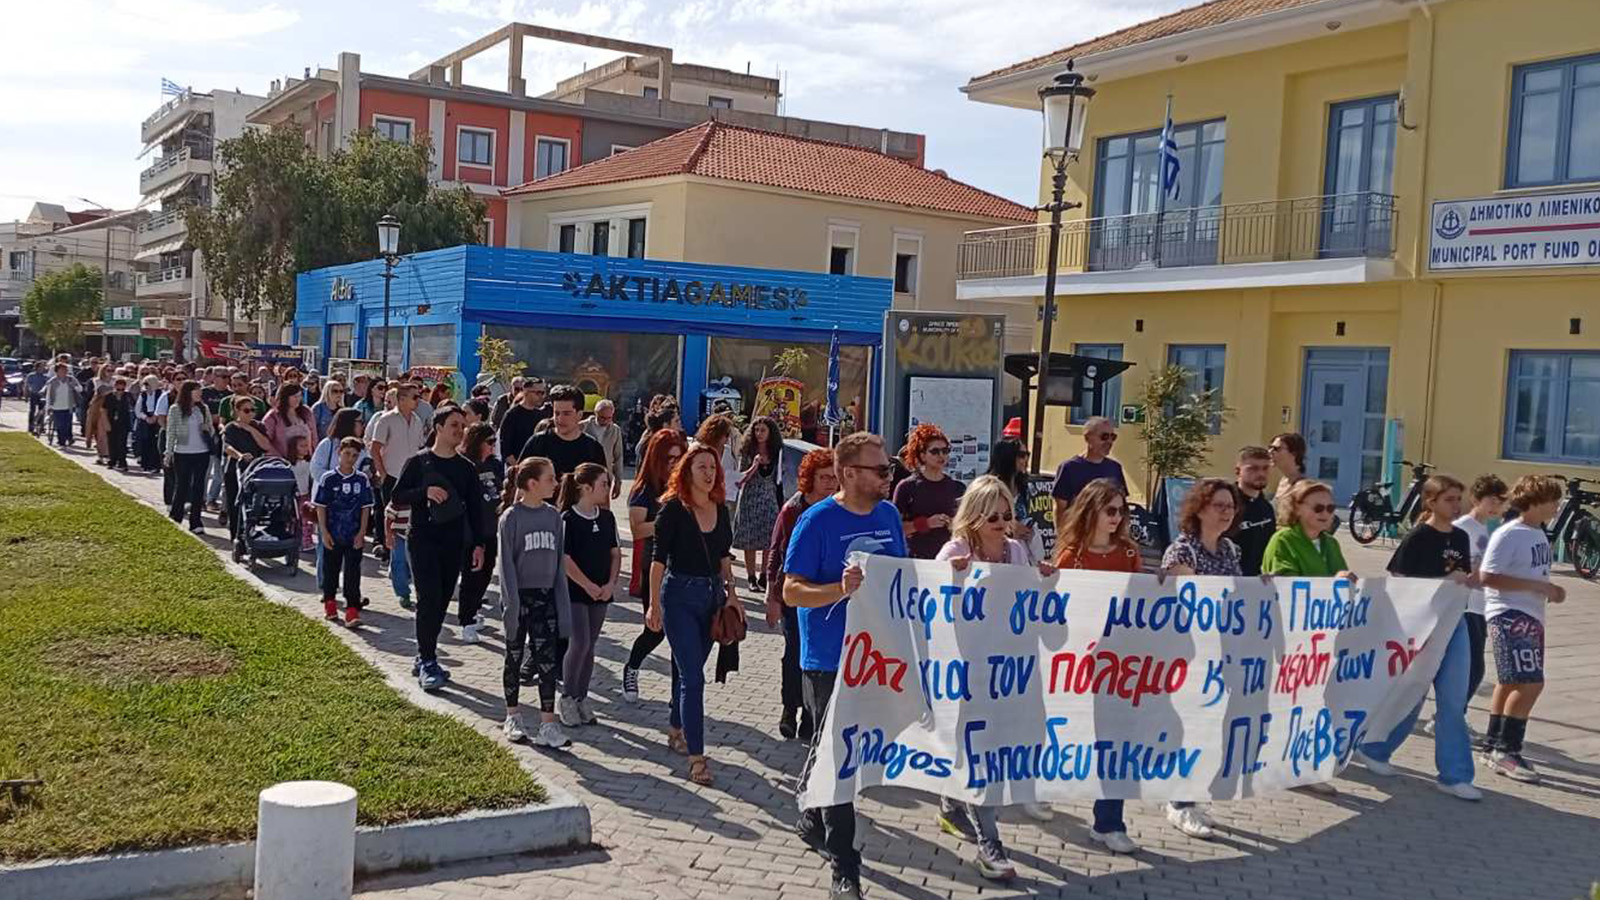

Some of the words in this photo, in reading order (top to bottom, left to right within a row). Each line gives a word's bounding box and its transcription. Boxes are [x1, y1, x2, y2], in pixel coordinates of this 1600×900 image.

[1469, 202, 1532, 221] ΔΗΜΟΤΙΚΟ
[1432, 245, 1497, 263] MUNICIPAL
[1503, 243, 1537, 261] PORT
[1544, 241, 1579, 258] FUND
[889, 568, 987, 640] Λεφτά
[1009, 588, 1071, 635] για
[1103, 581, 1246, 637] μισθούς
[988, 655, 1036, 699] τον
[1241, 657, 1266, 696] τα
[1275, 633, 1330, 705] κέρδη
[1336, 648, 1376, 683] των
[964, 716, 1202, 789] Εκπαιδευτικών
